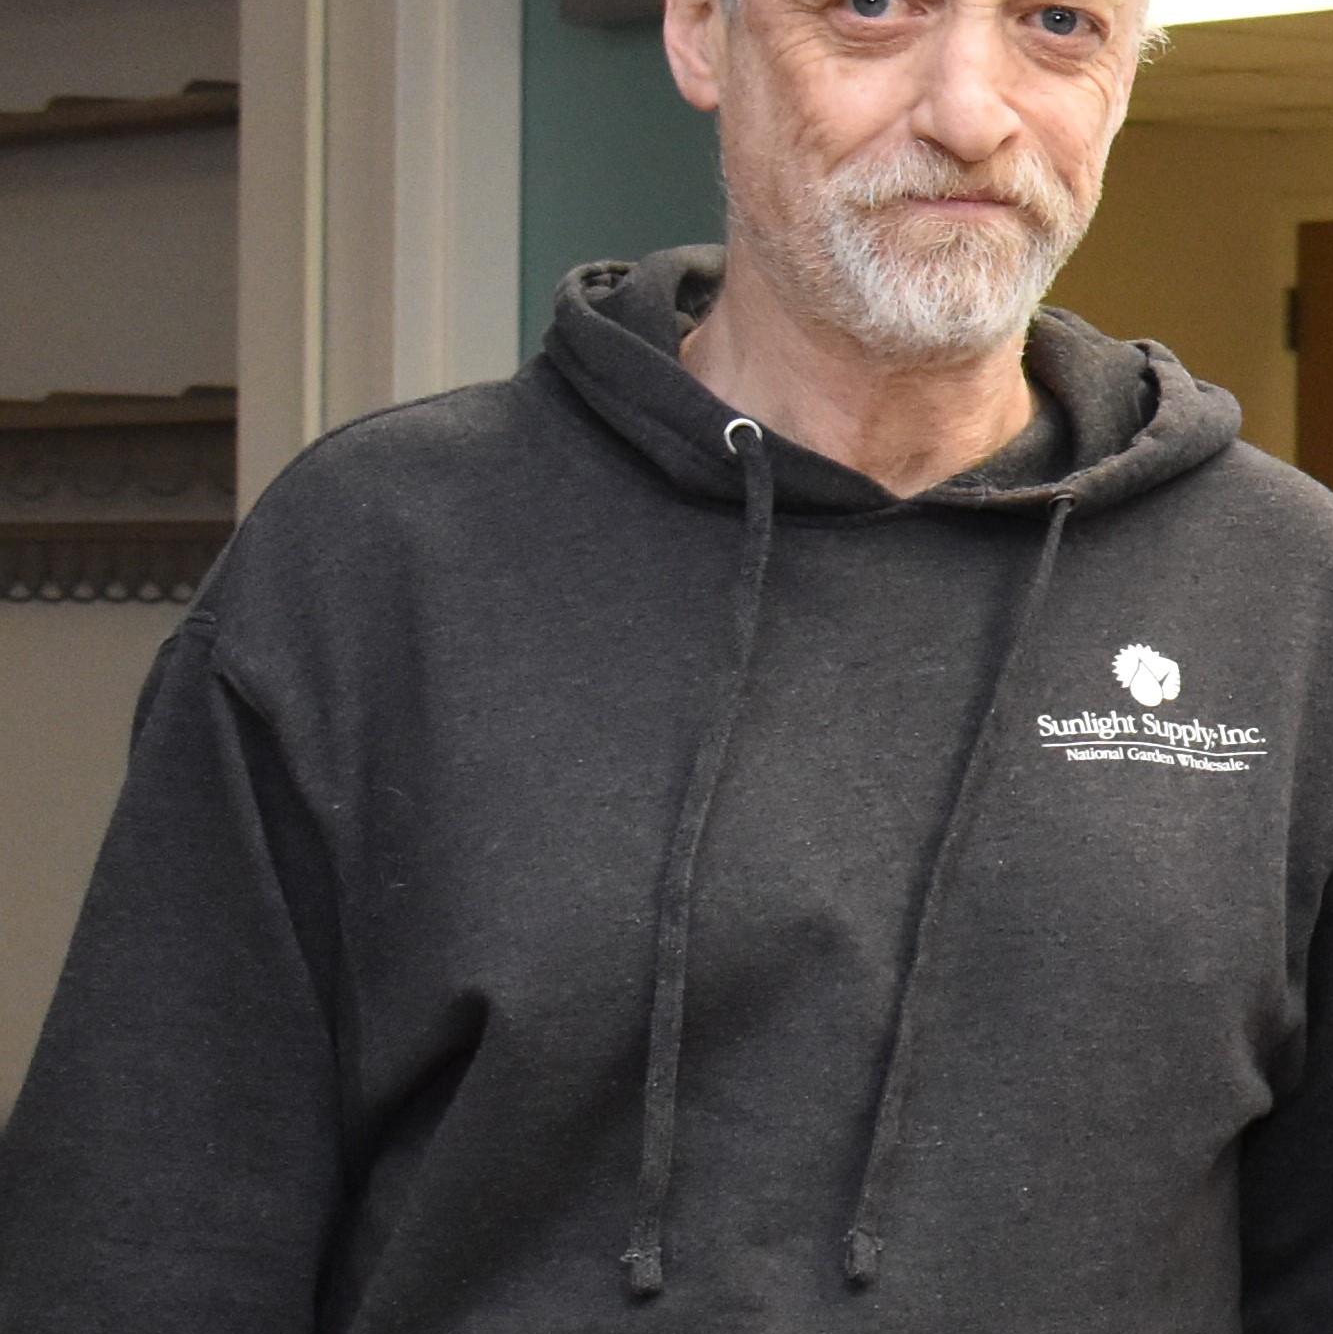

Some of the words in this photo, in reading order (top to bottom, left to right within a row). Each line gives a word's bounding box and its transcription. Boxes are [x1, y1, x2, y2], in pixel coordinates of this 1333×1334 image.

[1037, 710, 1139, 740] Sunlight
[1217, 723, 1267, 746] Inc.
[1065, 747, 1125, 762] National
[1126, 747, 1175, 765] Garden
